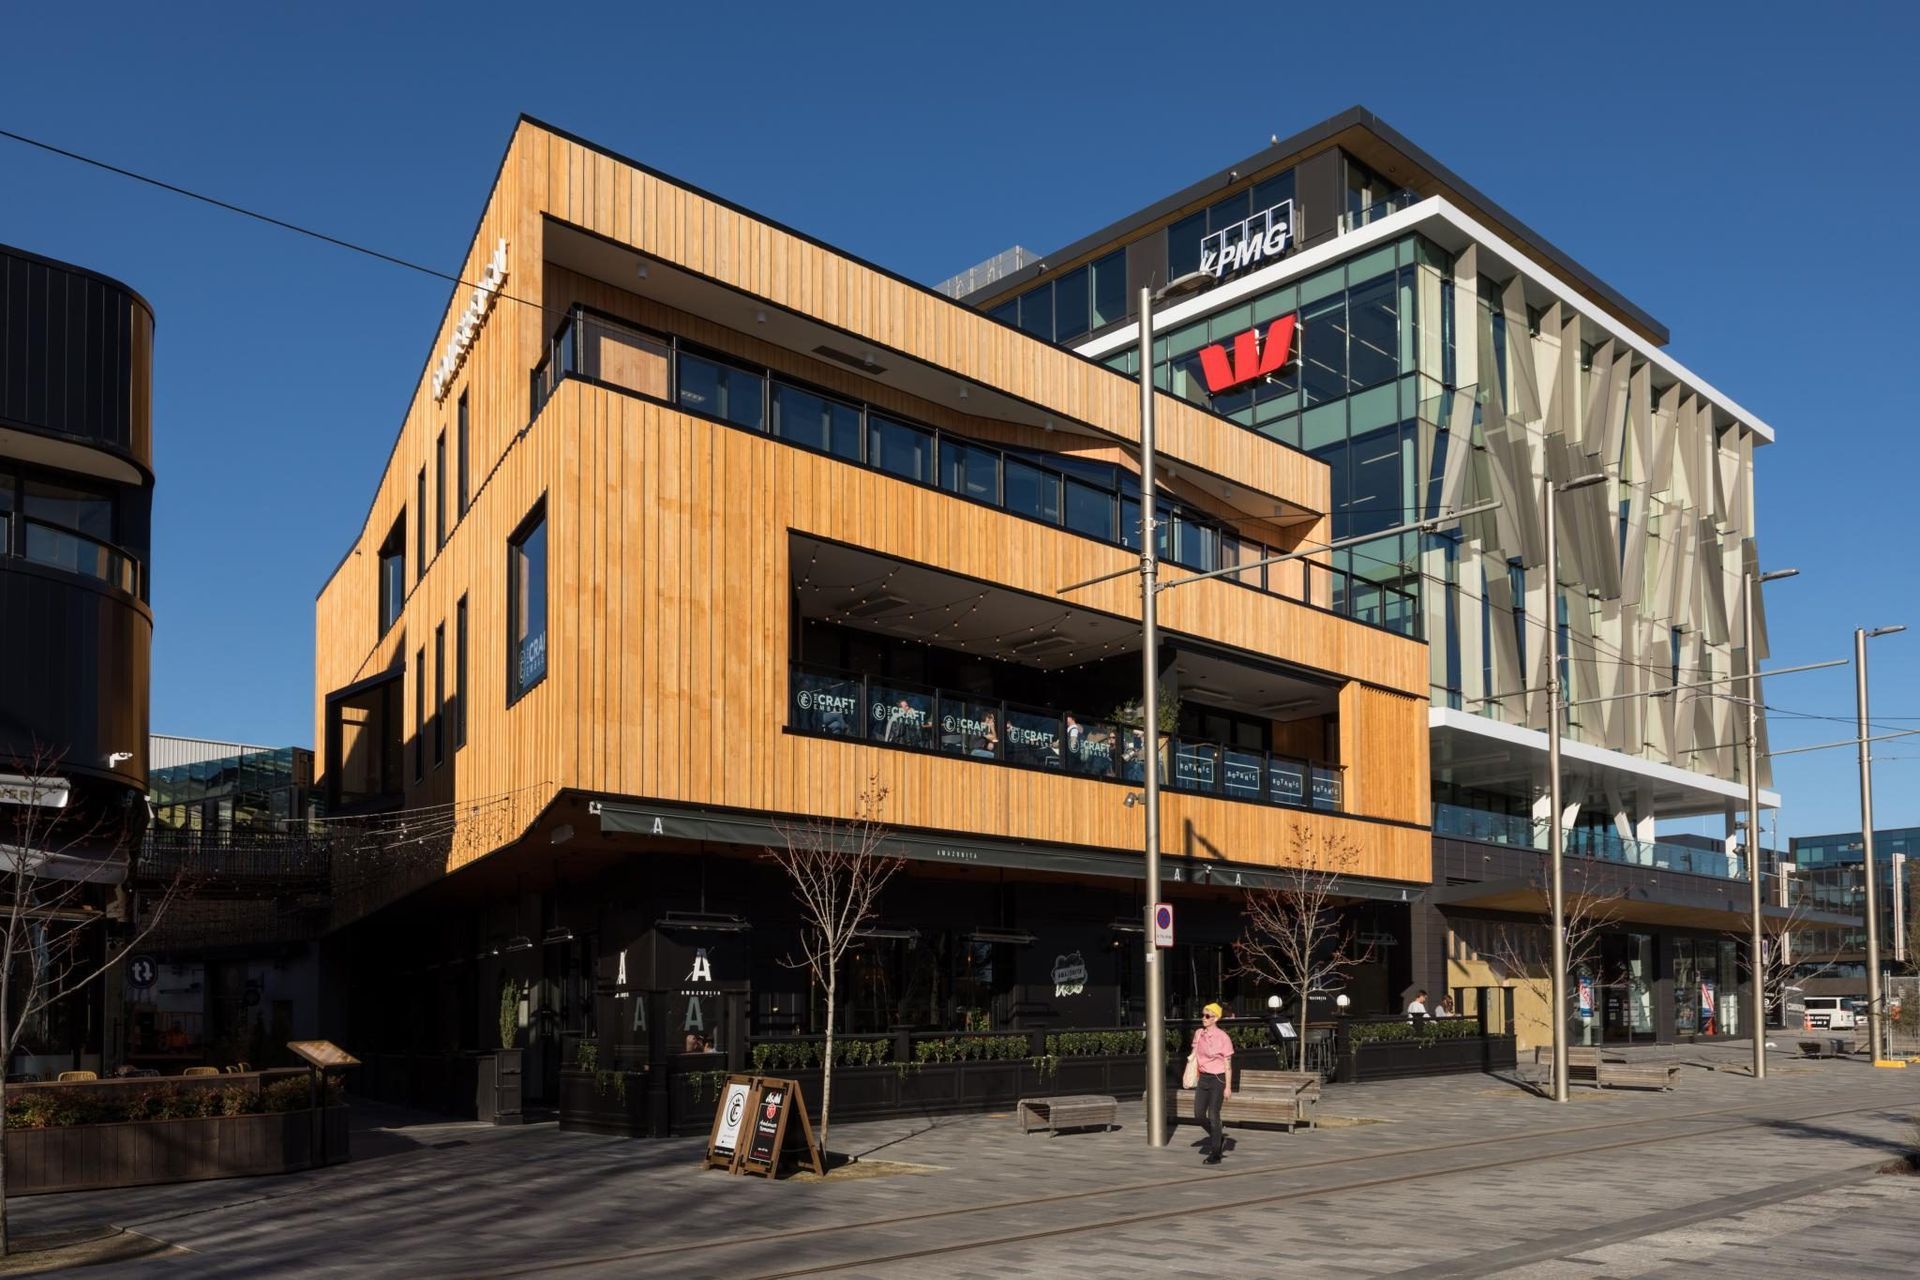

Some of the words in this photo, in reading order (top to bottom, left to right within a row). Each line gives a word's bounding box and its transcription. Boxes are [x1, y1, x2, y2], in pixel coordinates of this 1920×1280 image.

[1199, 222, 1288, 278] KPMG
[813, 703, 854, 715] EMBASSY
[818, 694, 856, 710] CRAFT
[891, 706, 926, 722] CRAFT
[961, 718, 992, 733] CRAFT
[1024, 729, 1054, 743] CRAFT
[1083, 740, 1111, 754] CRAFT
[1180, 763, 1210, 774] BOTANIC
[1227, 771, 1256, 782] BOTANIC
[1272, 778, 1299, 789] BOTANIC
[1313, 784, 1339, 795] BOTANIC
[652, 817, 664, 834] A
[692, 948, 713, 982] A
[684, 996, 704, 1031] A
